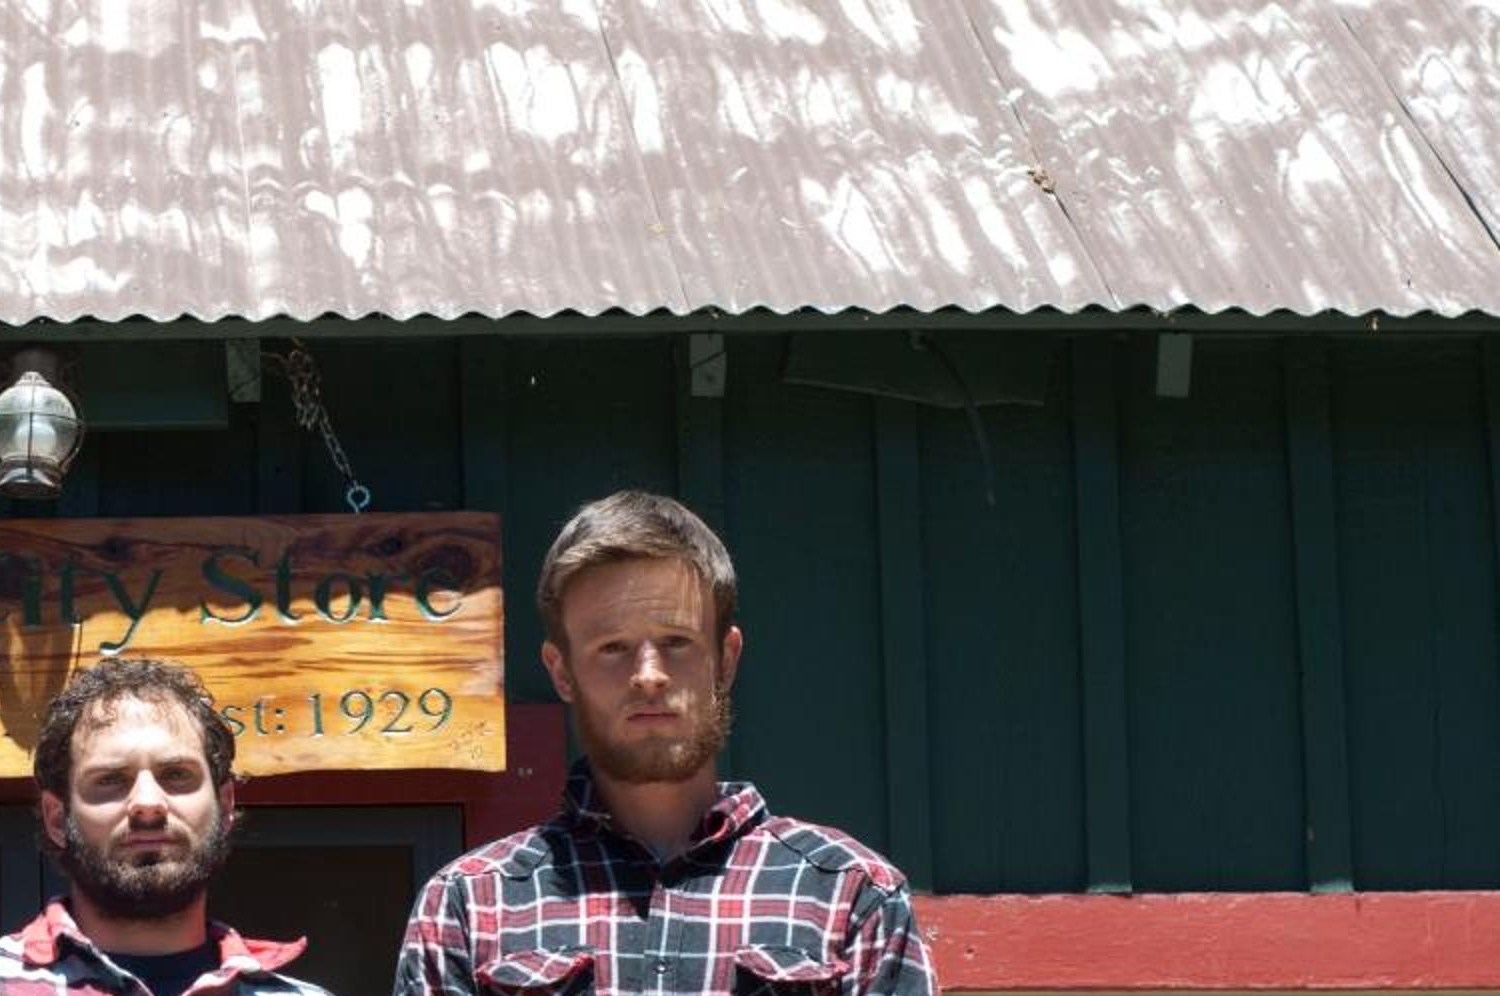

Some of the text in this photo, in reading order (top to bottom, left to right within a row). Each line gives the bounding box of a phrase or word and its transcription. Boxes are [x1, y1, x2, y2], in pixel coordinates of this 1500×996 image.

[200, 546, 462, 626] Store
[220, 698, 288, 738] st:
[308, 687, 453, 737] 1929
